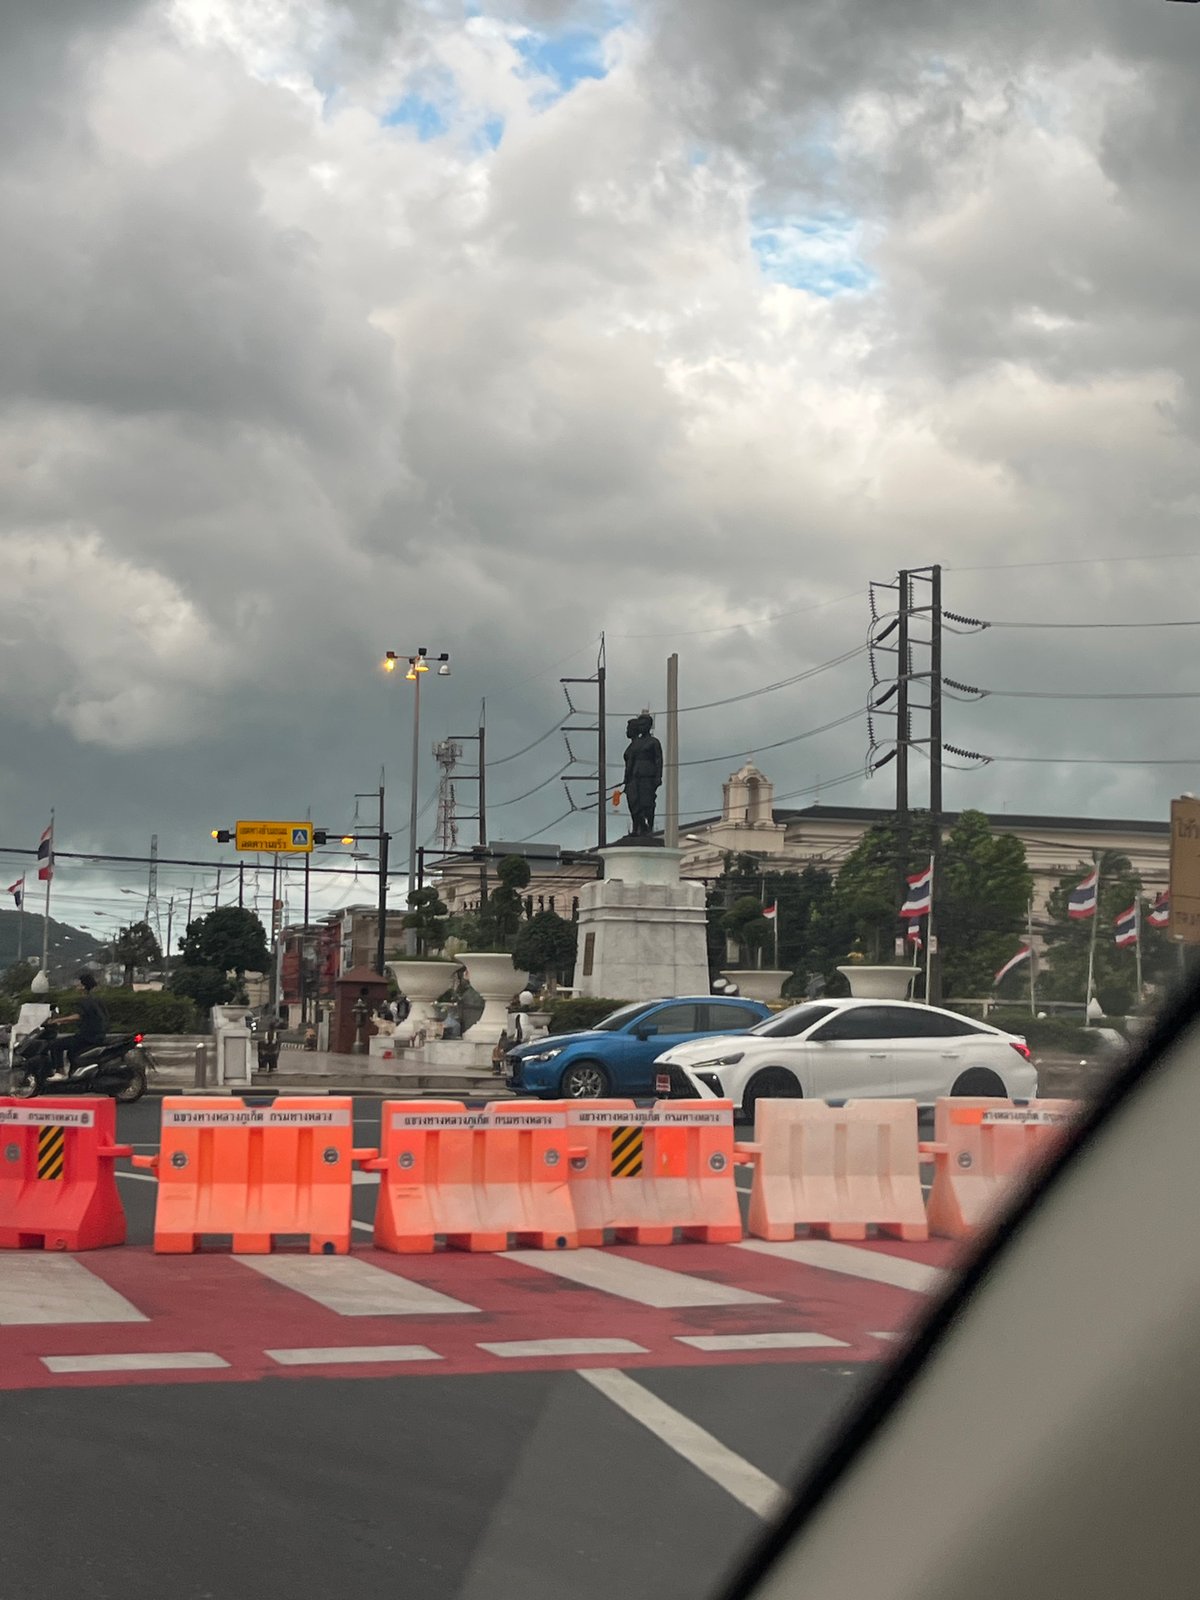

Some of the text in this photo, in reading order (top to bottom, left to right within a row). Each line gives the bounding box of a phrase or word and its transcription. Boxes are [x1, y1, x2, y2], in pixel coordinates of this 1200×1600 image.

[28, 1112, 78, 1121] กรมทางหลวง
[173, 1110, 332, 1124] แขวงทางหลวงภูเก็ต กรมทางหลวง
[404, 1113, 552, 1128] แขวงทางหลวงภูเก็ต กรมทางหลวง
[579, 1110, 720, 1125] แขวงทางหลวงภูเก็ต กรมทางหลวง
